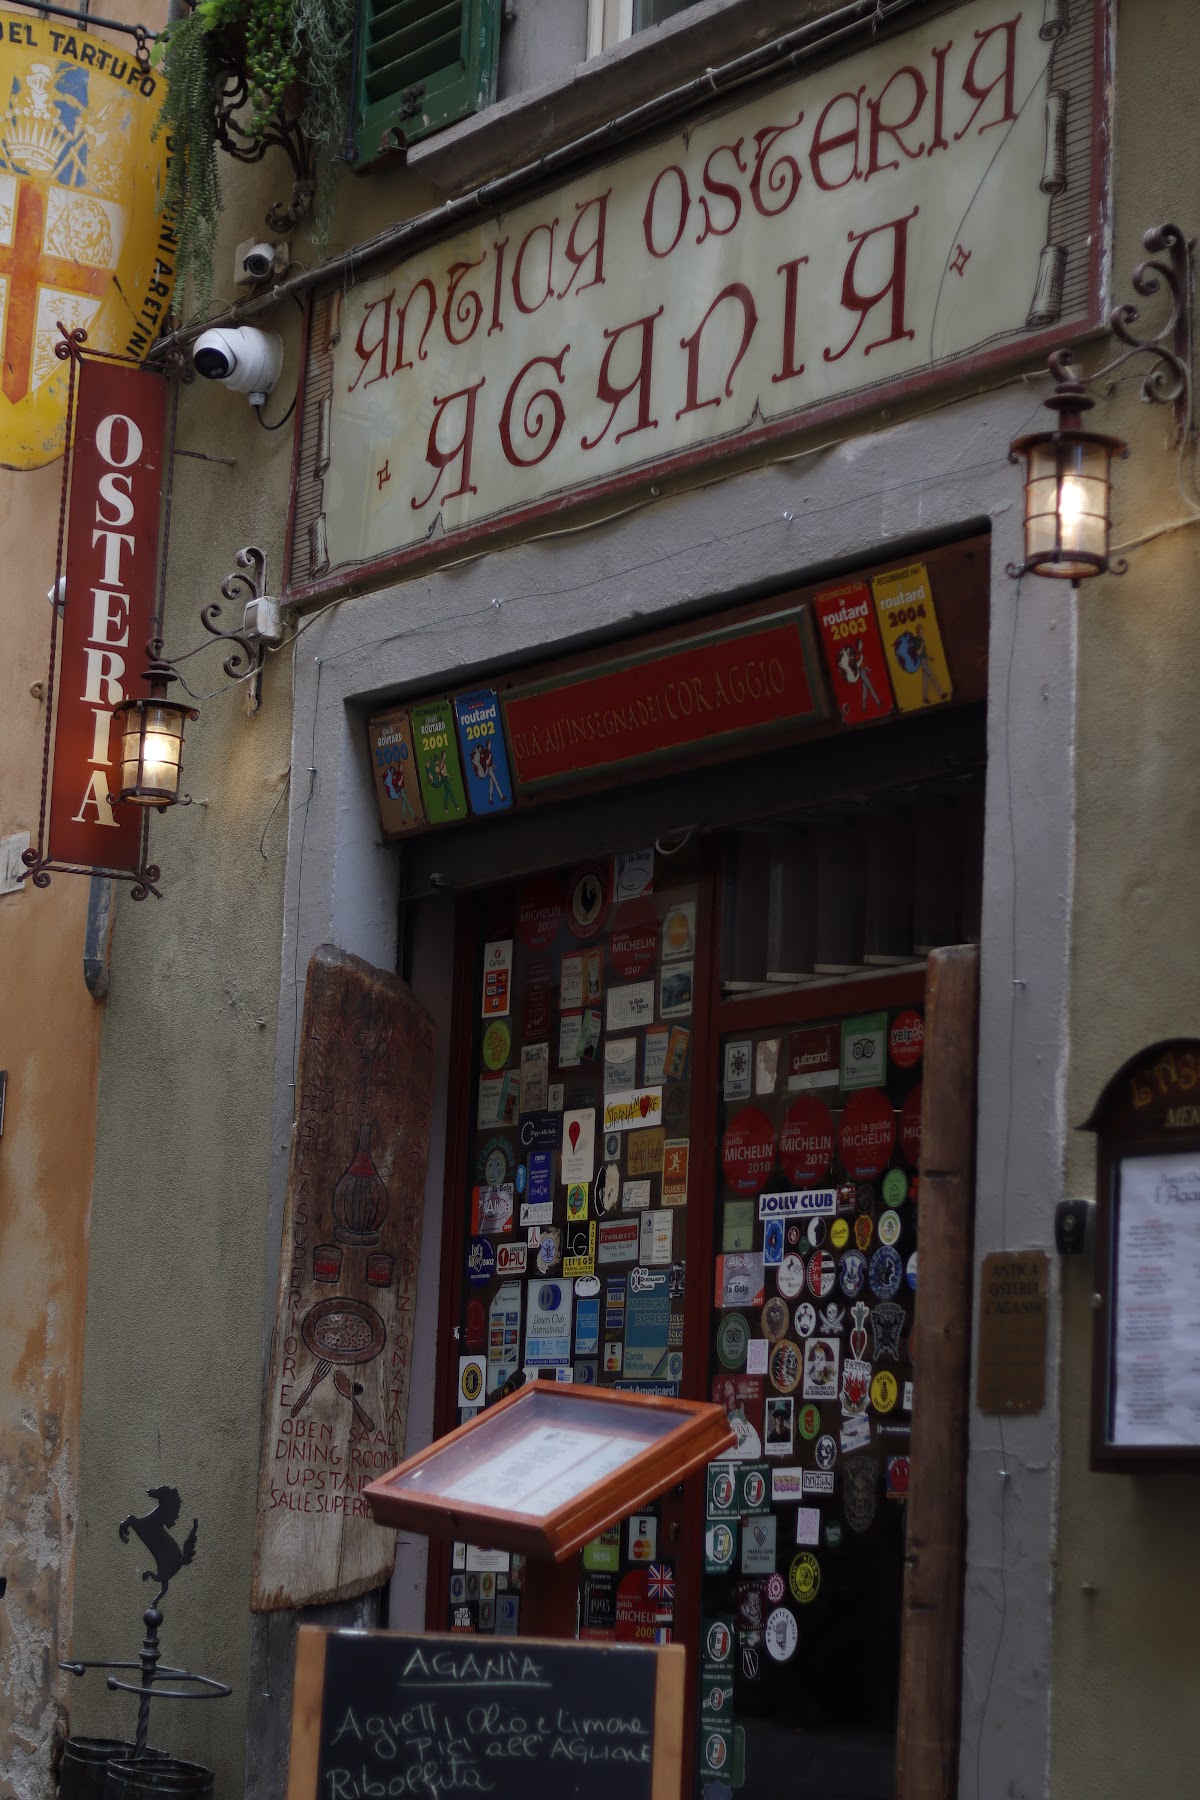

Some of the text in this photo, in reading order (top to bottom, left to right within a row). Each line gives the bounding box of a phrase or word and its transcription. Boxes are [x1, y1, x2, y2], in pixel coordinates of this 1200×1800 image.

[49, 30, 156, 97] TARTUFO
[348, 13, 1022, 393] ANTICA OSTERIA
[126, 256, 174, 358] ARETINI
[411, 206, 920, 511] AGANIA
[880, 584, 925, 610] routard
[71, 413, 144, 828] OSTERIA
[823, 600, 869, 627] routard
[888, 603, 926, 628] 2004
[831, 617, 868, 641] 2003
[461, 704, 496, 726] routard
[421, 721, 446, 736] ROUTARD
[466, 721, 496, 740] 2002
[377, 732, 403, 748] ROUTARD
[423, 733, 449, 752] 2001
[375, 742, 409, 767] 2000
[519, 905, 561, 923] MICHELIN
[612, 936, 657, 953] MICHELIN
[624, 965, 641, 976] 2007
[890, 1029, 914, 1045] yelp
[646, 1054, 663, 1067] 2006
[782, 1126, 801, 1138] guida
[861, 1123, 869, 1132] la
[869, 1120, 891, 1134] guida
[725, 1136, 743, 1148] guida
[781, 1135, 832, 1152] MICHELIN
[842, 1130, 891, 1148] MICHELIN
[724, 1143, 773, 1162] MICHELIN
[805, 1153, 829, 1165] 2012
[747, 1162, 771, 1174] 2010
[664, 1184, 686, 1194] GUIDES
[761, 1193, 833, 1212] JOLLY CLUB
[600, 1230, 636, 1241] Frommer's
[564, 1256, 593, 1267] LET'S GO
[992, 1263, 1040, 1277] ANTICA
[726, 1284, 749, 1294] la Gola
[610, 1293, 622, 1301] VISA
[627, 1298, 669, 1311] AMERICAN
[533, 1313, 565, 1325] Diners Club
[635, 1313, 670, 1326] EXPRESS
[668, 1314, 684, 1322] SOLO
[624, 1352, 644, 1361] Cards
[624, 1360, 654, 1370] Welcome
[873, 1397, 894, 1410] SECURITY
[281, 1419, 396, 1446] OBEN SAAL
[275, 1439, 397, 1469] DINING ROOM
[269, 1489, 312, 1513] SALLE
[600, 1535, 619, 1547] Italia
[590, 1599, 611, 1613] 1995
[616, 1600, 633, 1609] guida
[635, 1626, 656, 1638] 2009
[467, 1703, 527, 1735] Olio
[537, 1717, 552, 1734] e
